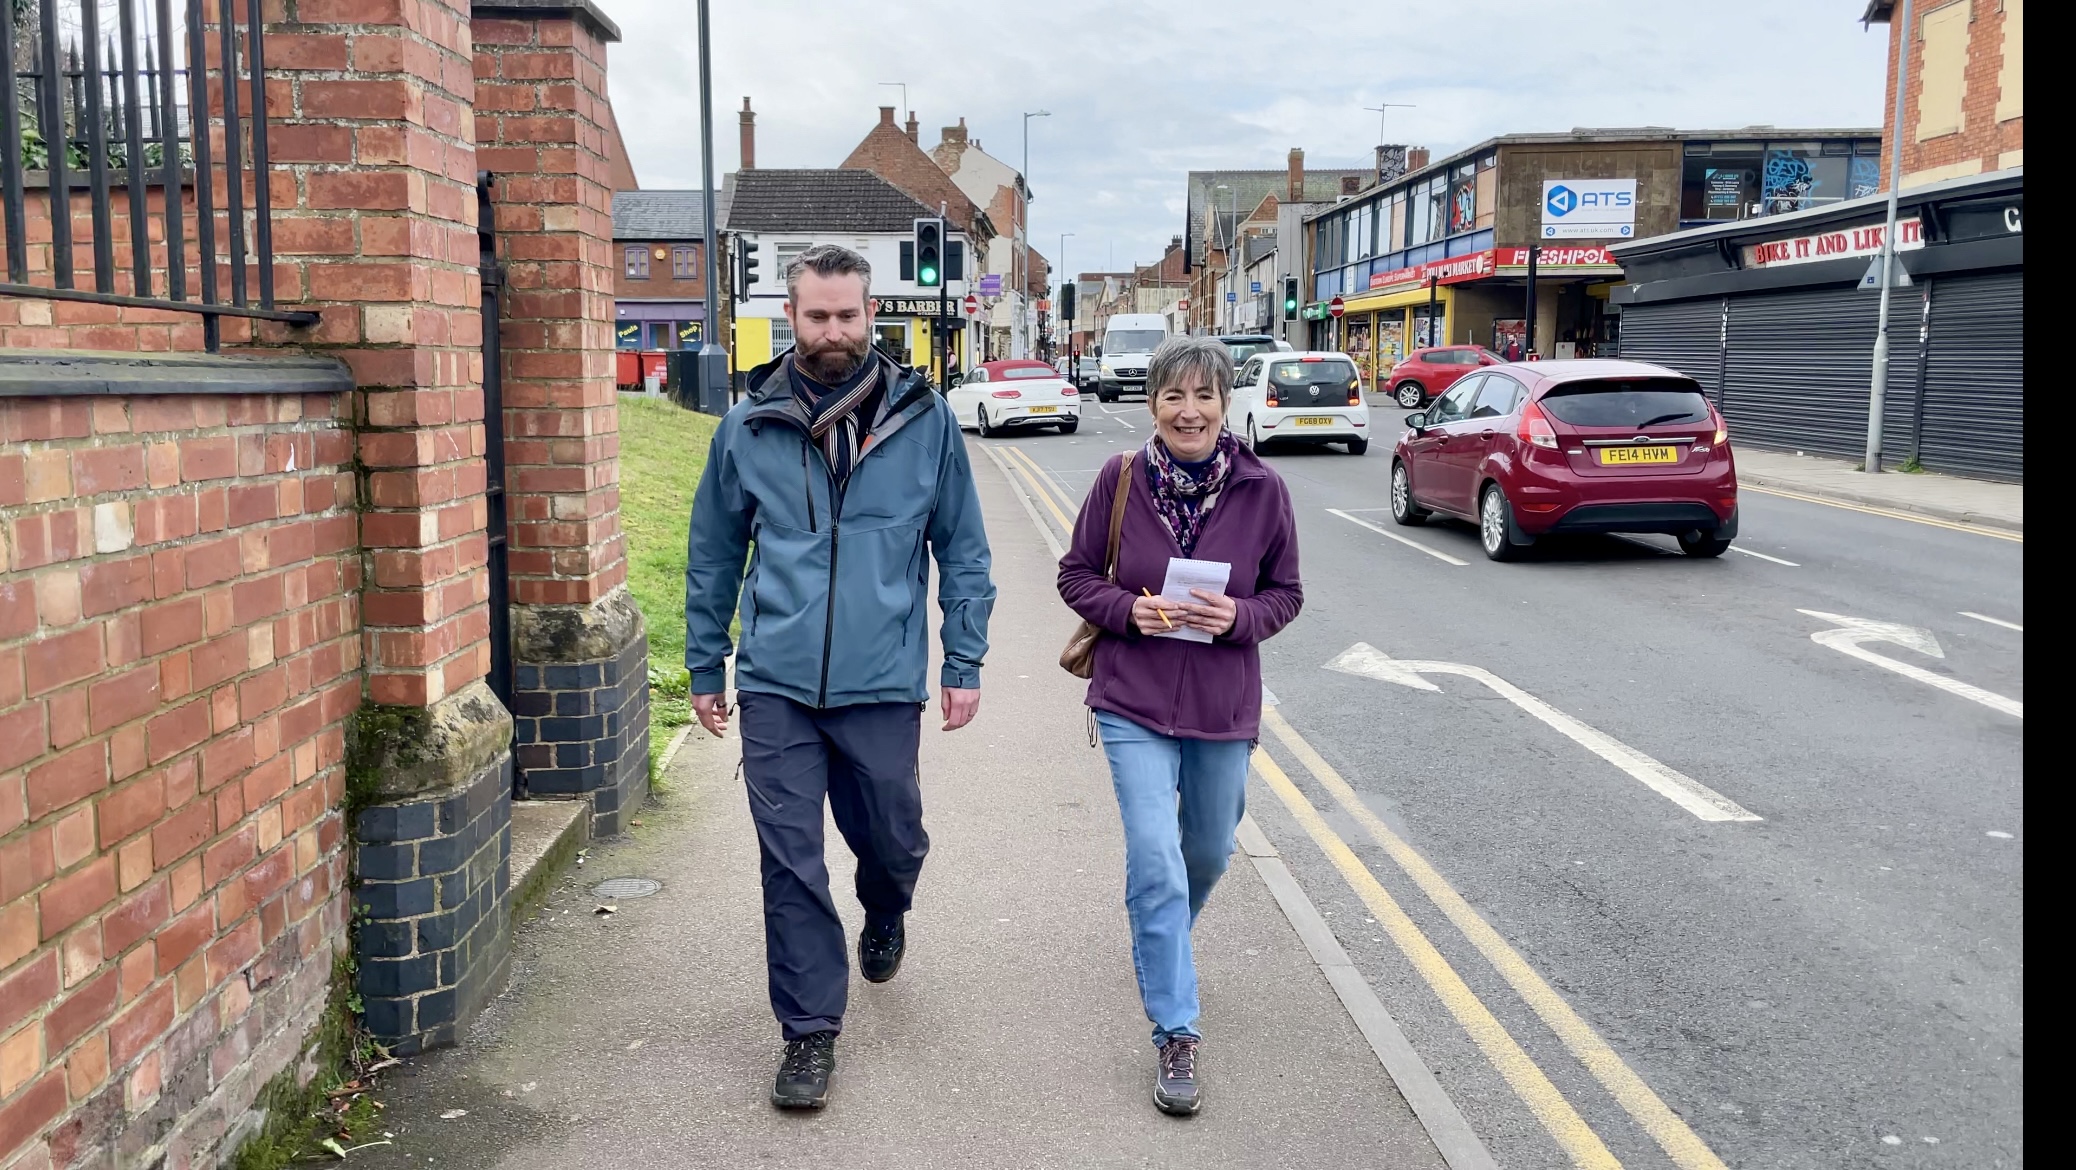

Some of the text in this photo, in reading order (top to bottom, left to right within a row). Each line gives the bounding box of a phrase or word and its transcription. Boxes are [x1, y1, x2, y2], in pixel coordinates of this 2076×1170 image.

[1581, 192, 1632, 207] ATS
[1755, 221, 1922, 264] BIKE IT AND LIK IT
[618, 324, 638, 338] Pauls
[680, 325, 698, 339] Shop
[1609, 447, 1669, 461] FE14 HVM
